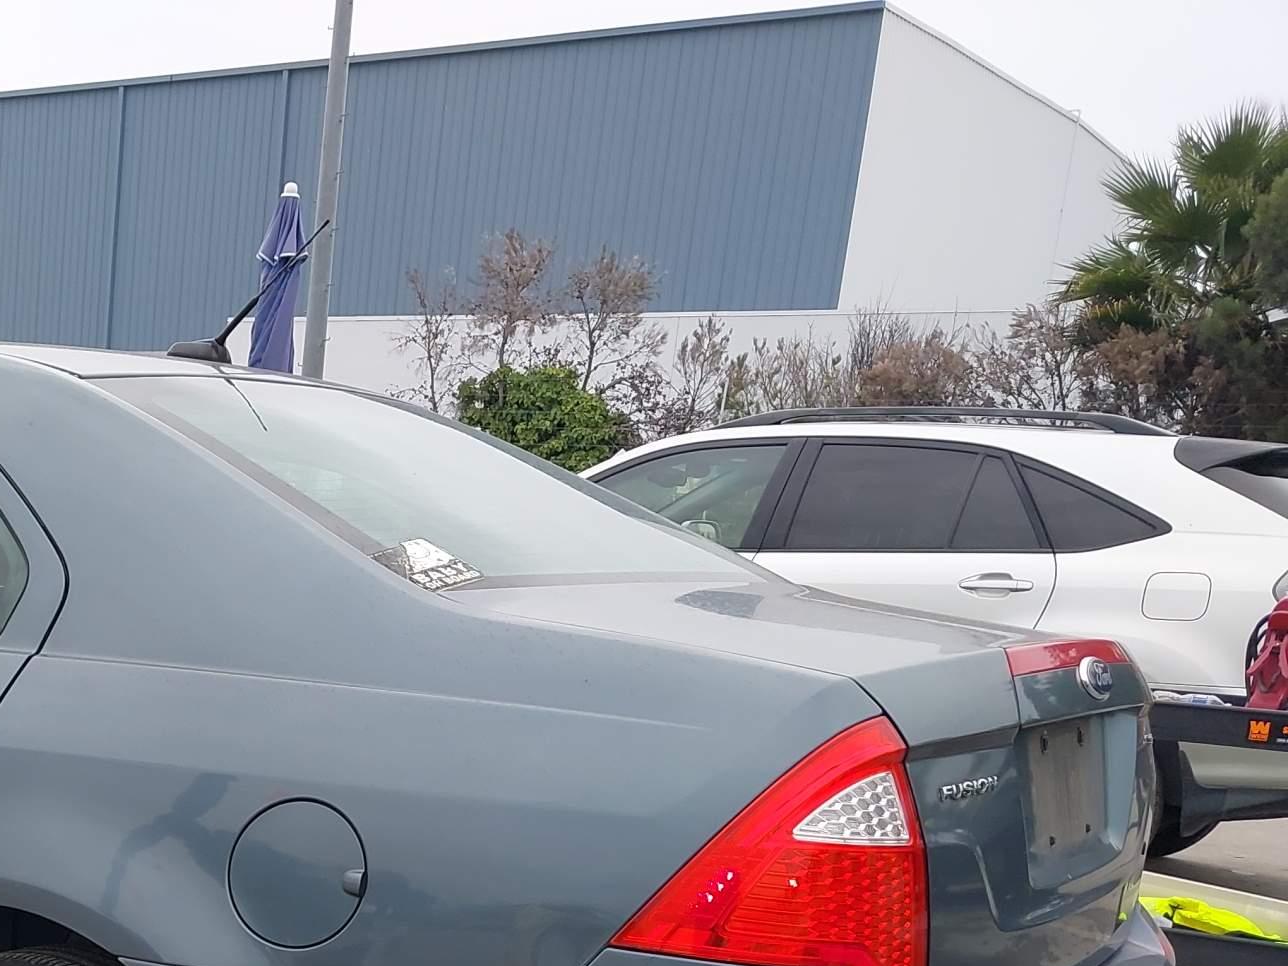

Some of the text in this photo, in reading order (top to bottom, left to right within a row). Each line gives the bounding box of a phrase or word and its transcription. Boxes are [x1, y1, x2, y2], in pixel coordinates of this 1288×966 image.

[411, 561, 468, 584] BABY
[443, 569, 481, 585] BOARD
[1093, 662, 1113, 686] Ford
[940, 775, 998, 801] FUSION
